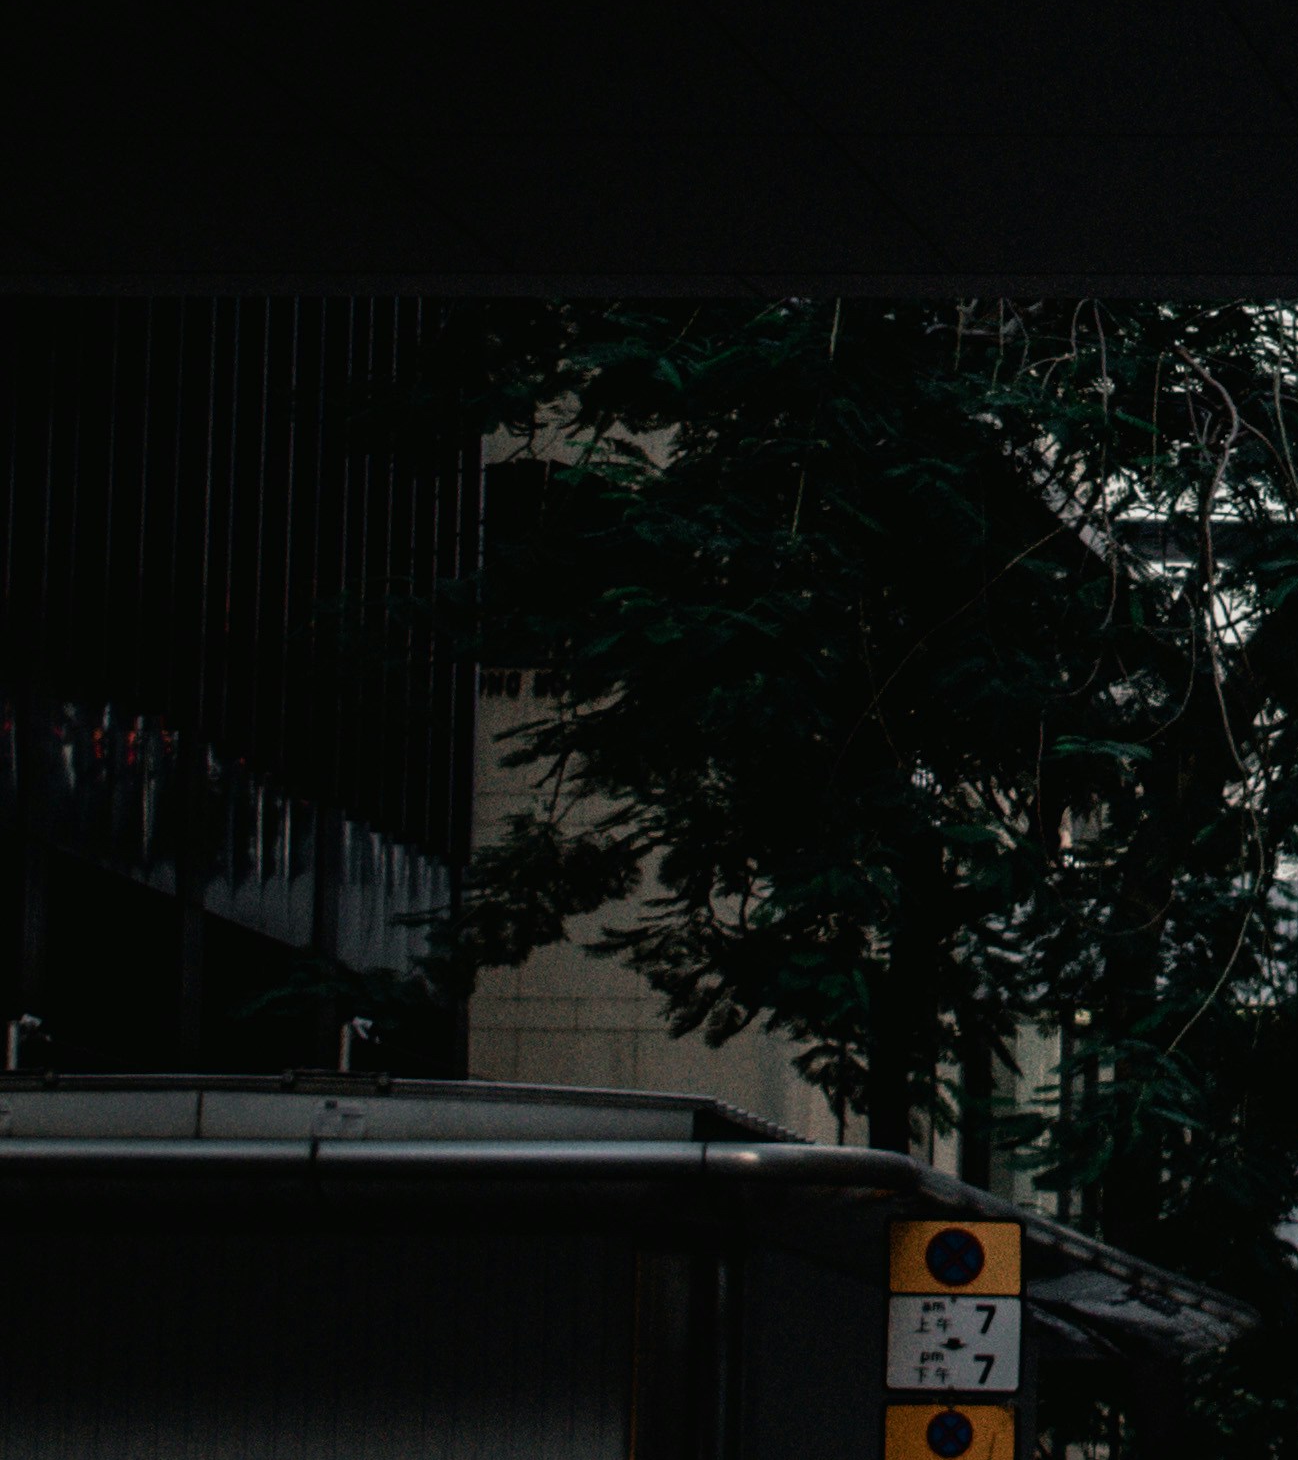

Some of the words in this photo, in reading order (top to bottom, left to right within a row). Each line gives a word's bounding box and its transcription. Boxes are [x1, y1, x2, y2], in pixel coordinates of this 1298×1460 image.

[911, 1316, 950, 1333] 上午
[922, 1301, 946, 1312] am
[975, 1305, 996, 1335] 7
[912, 1365, 949, 1384] 下午
[920, 1351, 944, 1364] pm
[974, 1354, 995, 1384] 7
